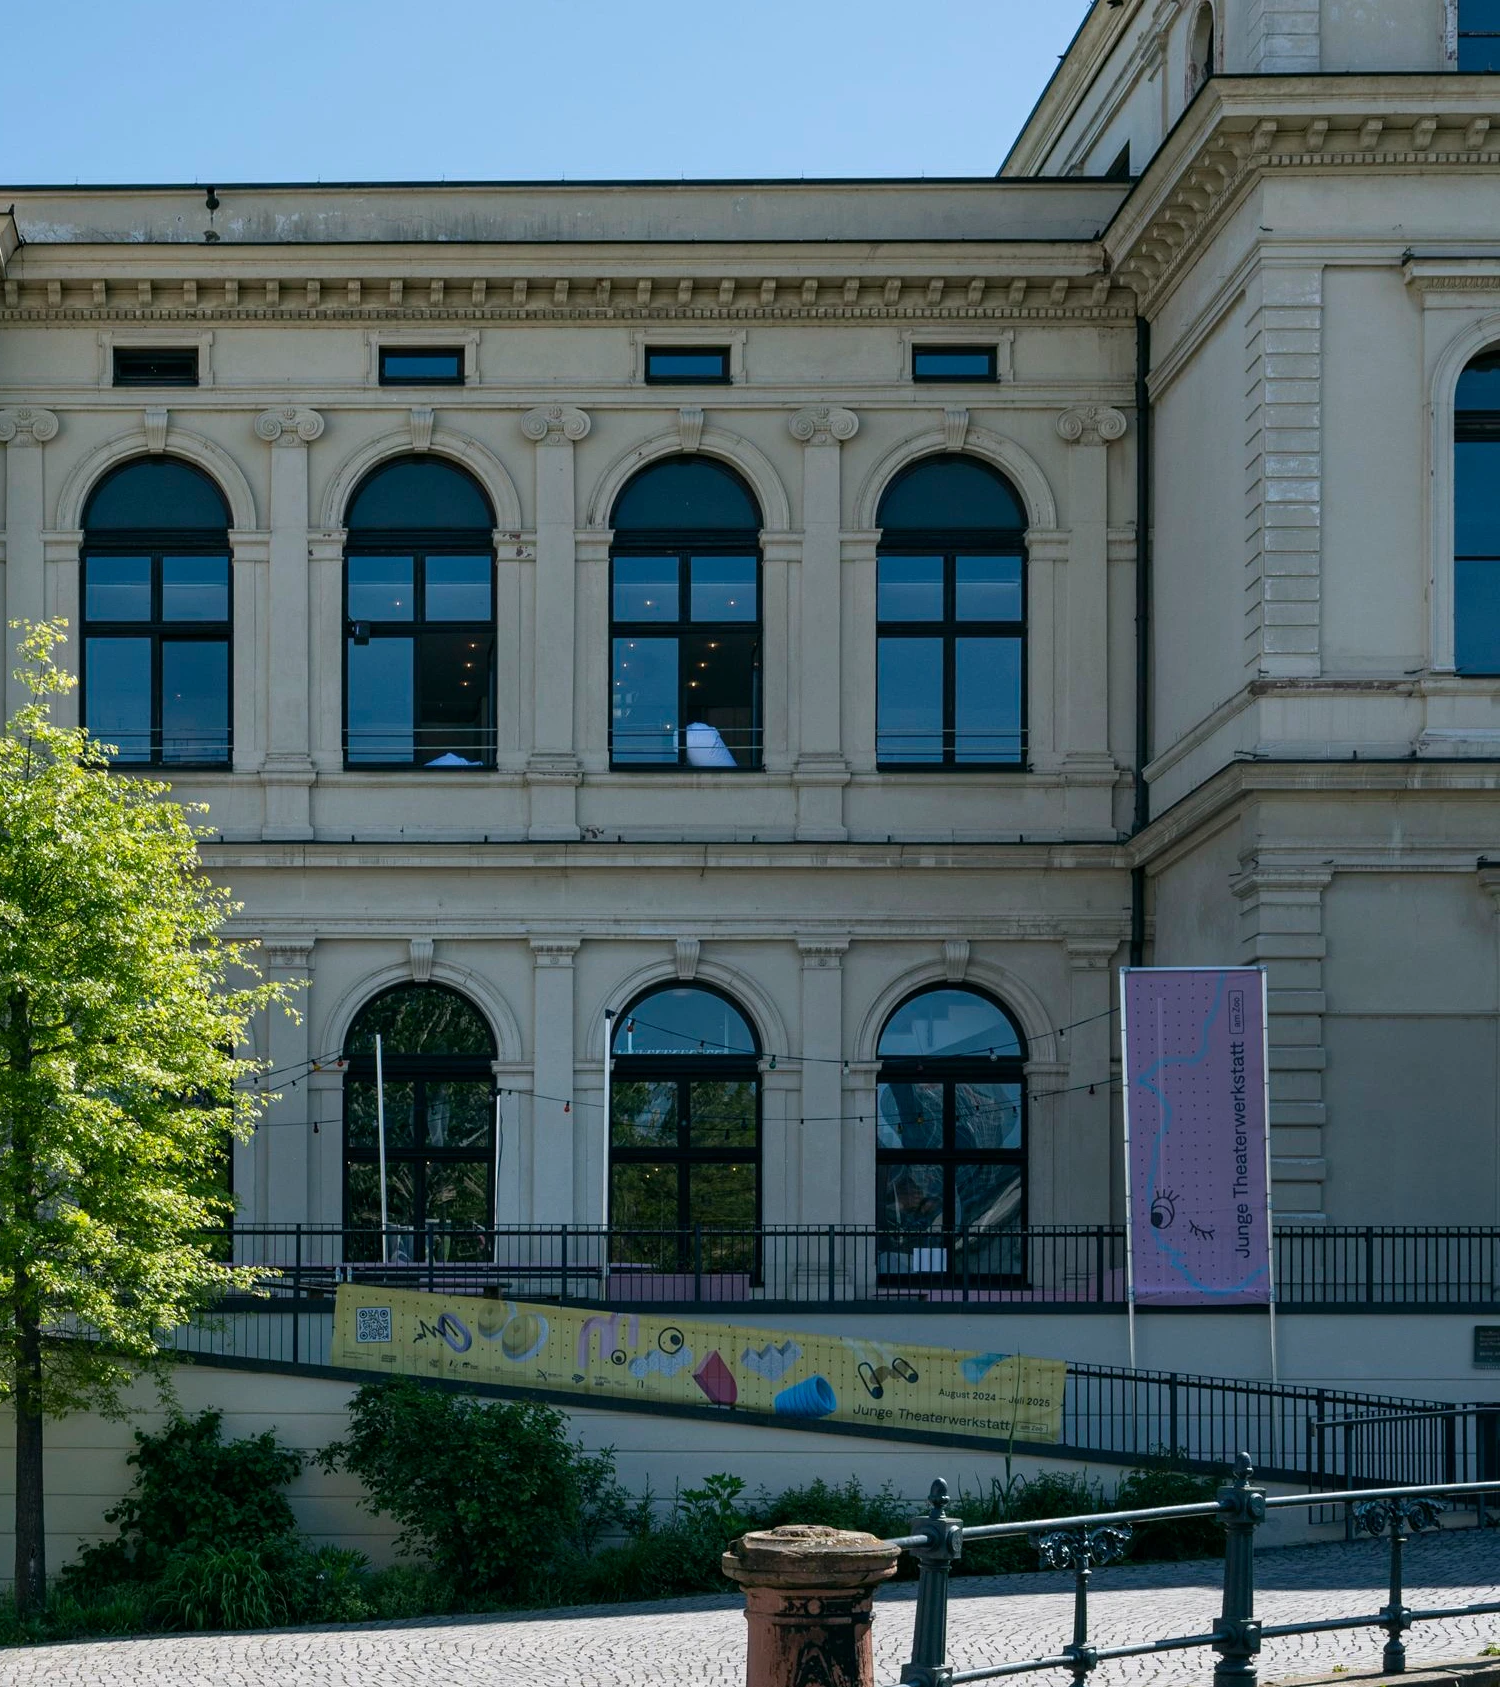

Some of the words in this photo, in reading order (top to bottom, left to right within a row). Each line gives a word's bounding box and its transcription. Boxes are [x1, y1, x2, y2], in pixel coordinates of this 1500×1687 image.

[1231, 996, 1242, 1012] Zoo
[1233, 1013, 1242, 1029] am
[1230, 1041, 1249, 1198] Theaterwerkstatt
[1234, 1202, 1253, 1259] Junge
[938, 1387, 970, 1400] August
[972, 1391, 997, 1402] 2024
[1008, 1394, 1025, 1405] Juli
[1026, 1397, 1051, 1408] 2025
[853, 1403, 893, 1420] Junge
[898, 1407, 1011, 1431] Theaterwerkstatt
